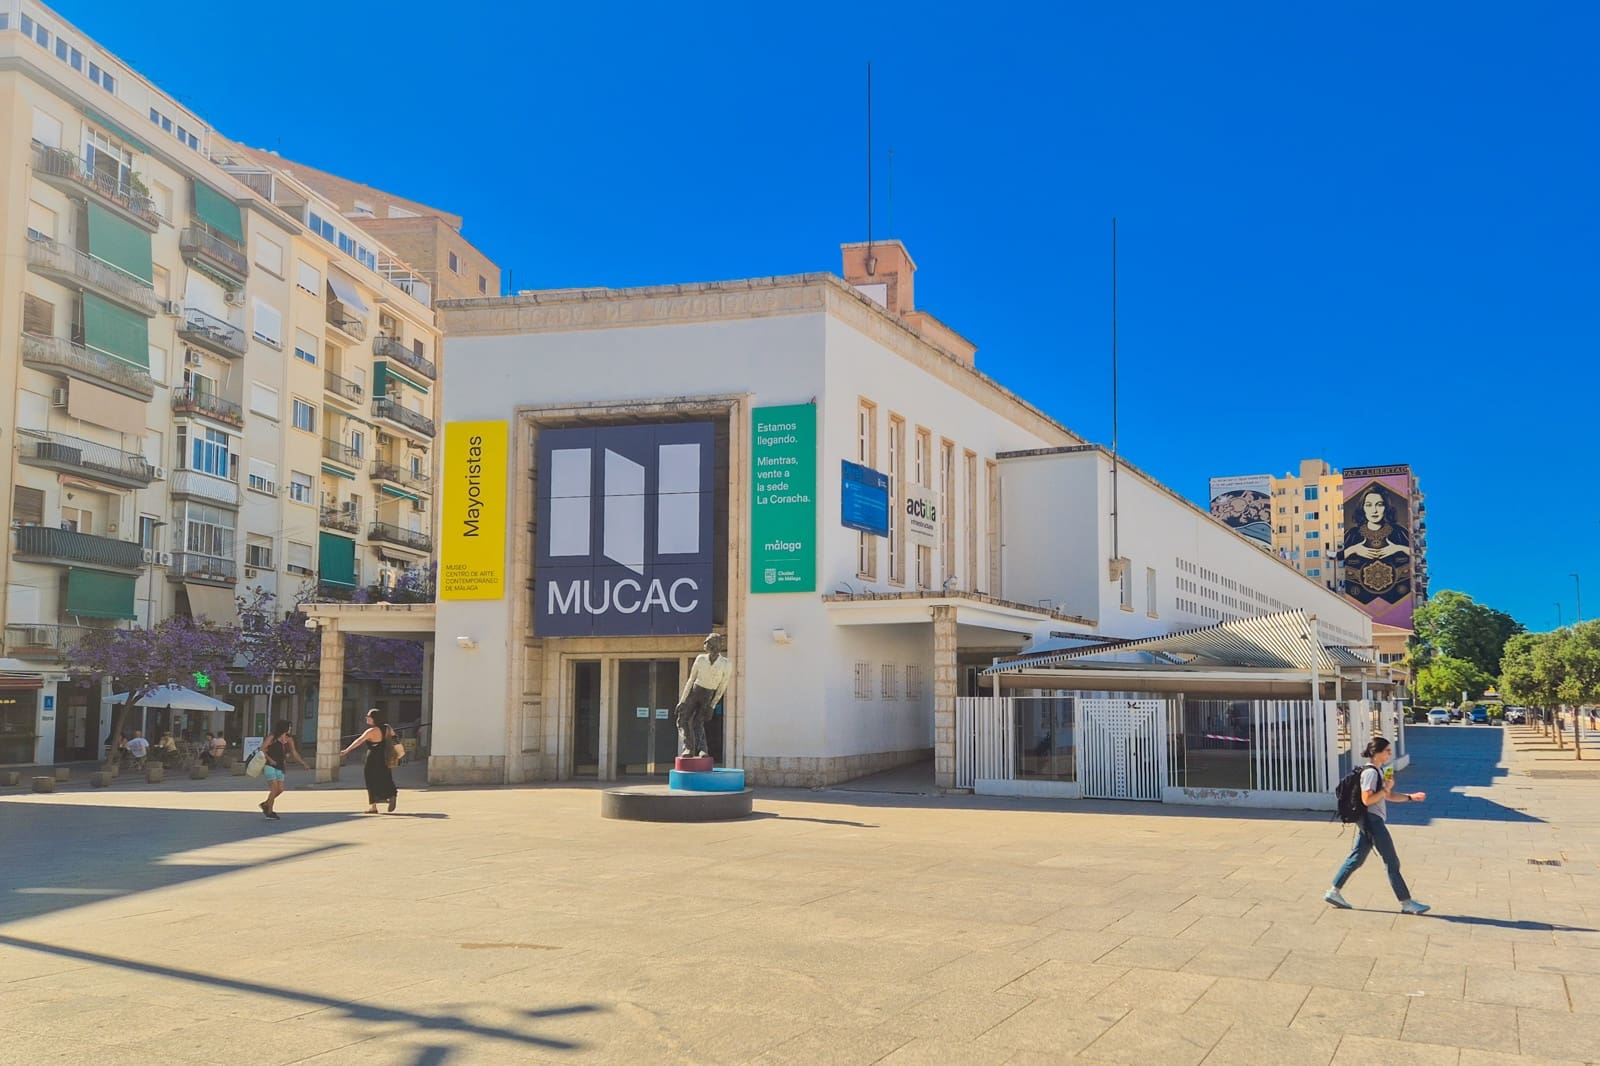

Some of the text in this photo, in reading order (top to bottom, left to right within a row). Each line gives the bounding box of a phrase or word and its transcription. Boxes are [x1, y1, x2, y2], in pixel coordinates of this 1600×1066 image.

[758, 423, 797, 433] Estamos
[758, 434, 798, 447] llegando.
[757, 456, 799, 467] Mientras,
[757, 470, 790, 479] vente a
[463, 435, 484, 537] Mayoristas
[757, 481, 789, 492] la sede
[757, 493, 811, 505] La Coracha.
[547, 577, 699, 615] MUCAC
[228, 681, 296, 694] farmacia
